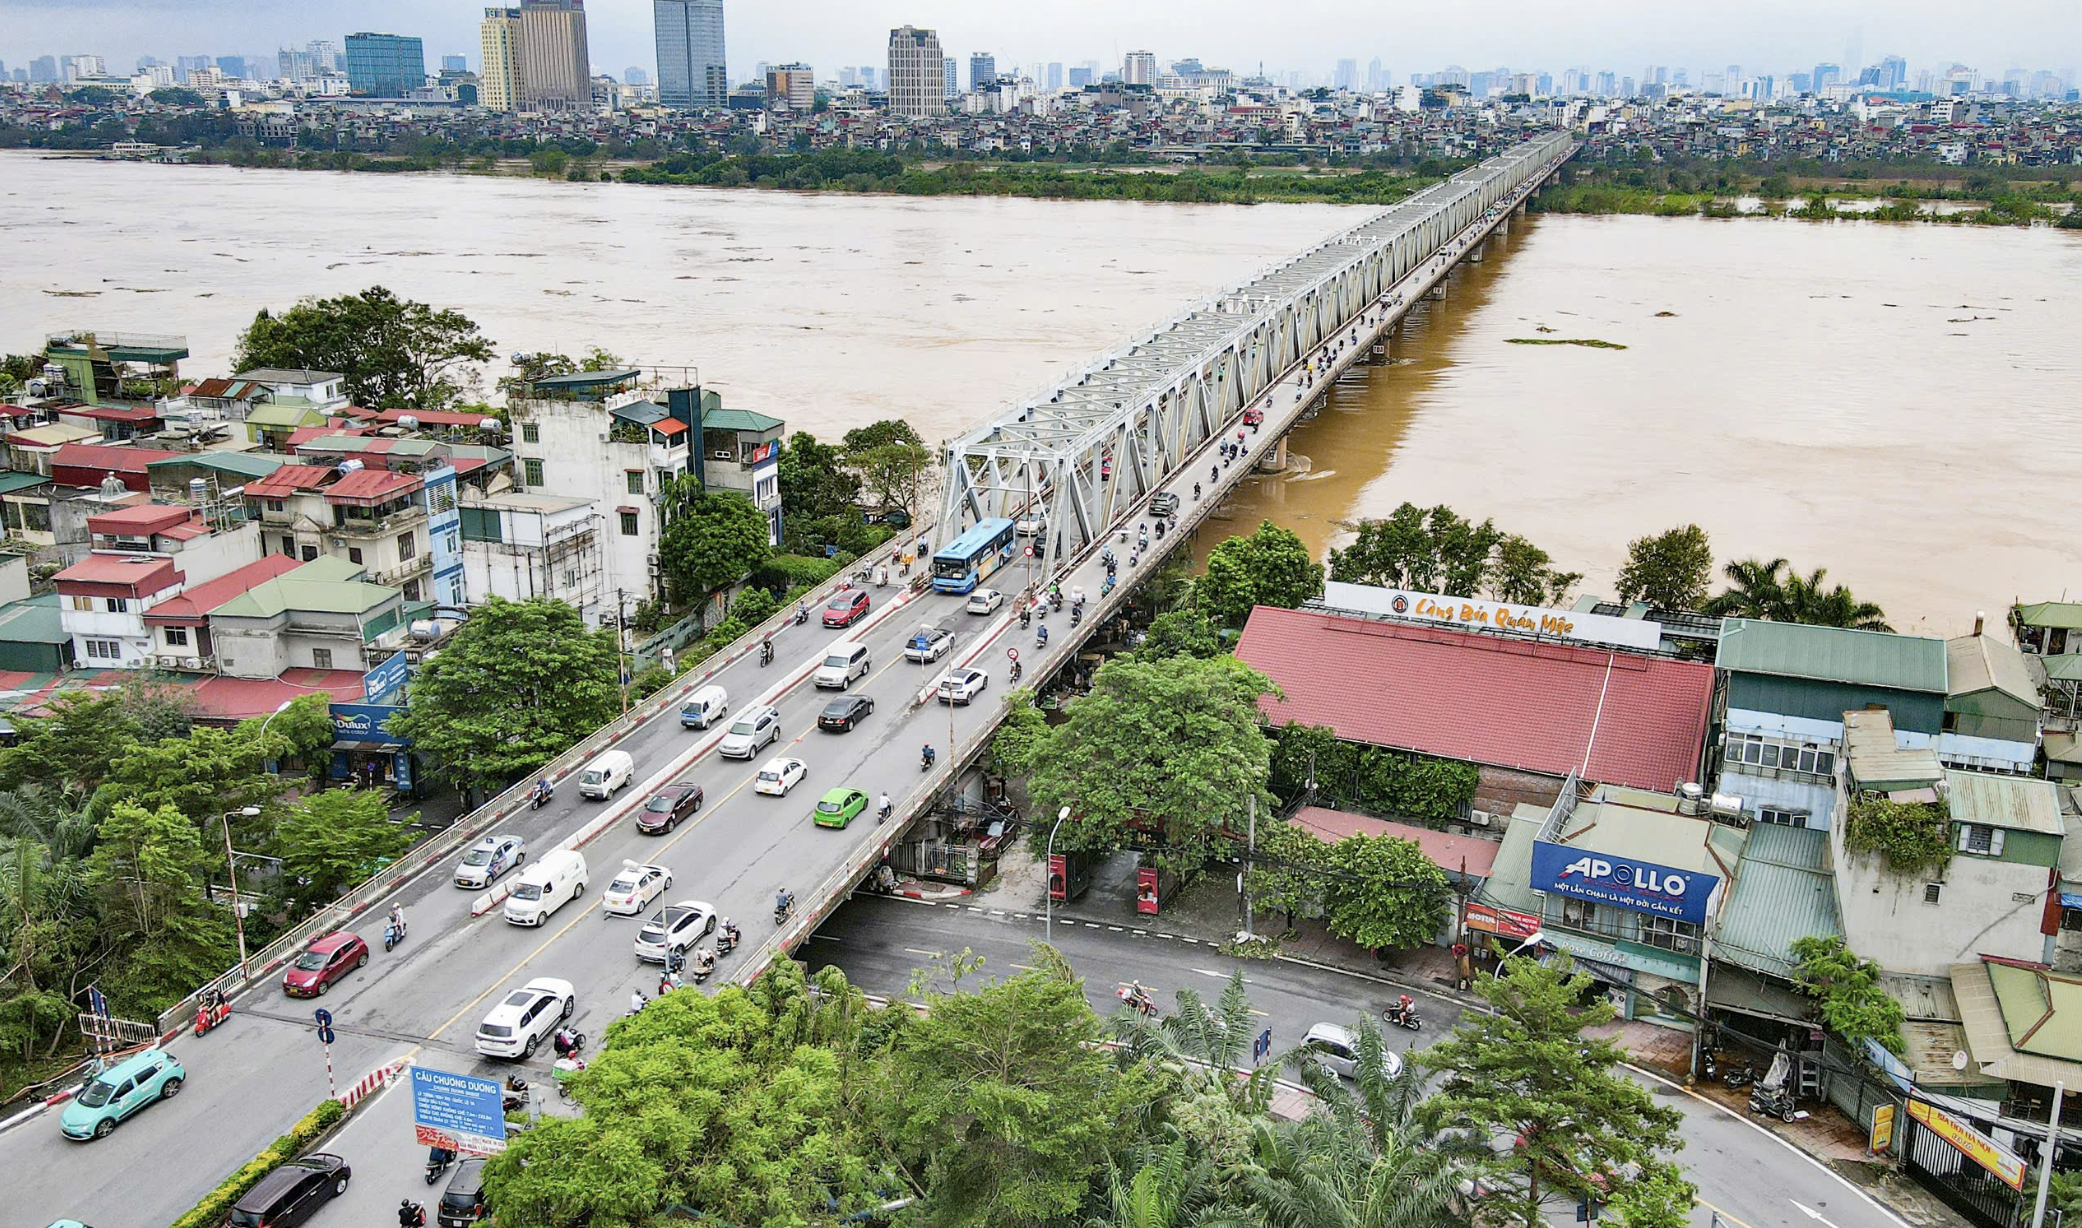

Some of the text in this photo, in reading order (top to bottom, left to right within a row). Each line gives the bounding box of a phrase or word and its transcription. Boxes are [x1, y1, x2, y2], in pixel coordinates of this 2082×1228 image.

[1416, 598, 1454, 622] Làng
[1460, 603, 1488, 625] Bia
[1495, 608, 1536, 631] Quán
[1541, 614, 1574, 637] Mộc
[336, 719, 369, 730] Dulux
[1558, 857, 1687, 897] APOLLO
[1554, 882, 1569, 893] MỘT
[1570, 883, 1585, 895] LẦN
[1586, 889, 1607, 899] CHẠM
[1609, 893, 1618, 902] LÀ
[1619, 896, 1634, 906] MỘT
[1669, 906, 1684, 916] KẾT
[1467, 911, 1496, 925] MOTUL
[1561, 941, 1627, 964] Rose Coffee
[433, 1075, 467, 1089] CHƯƠNG
[468, 1081, 497, 1095] DƯƠNG
